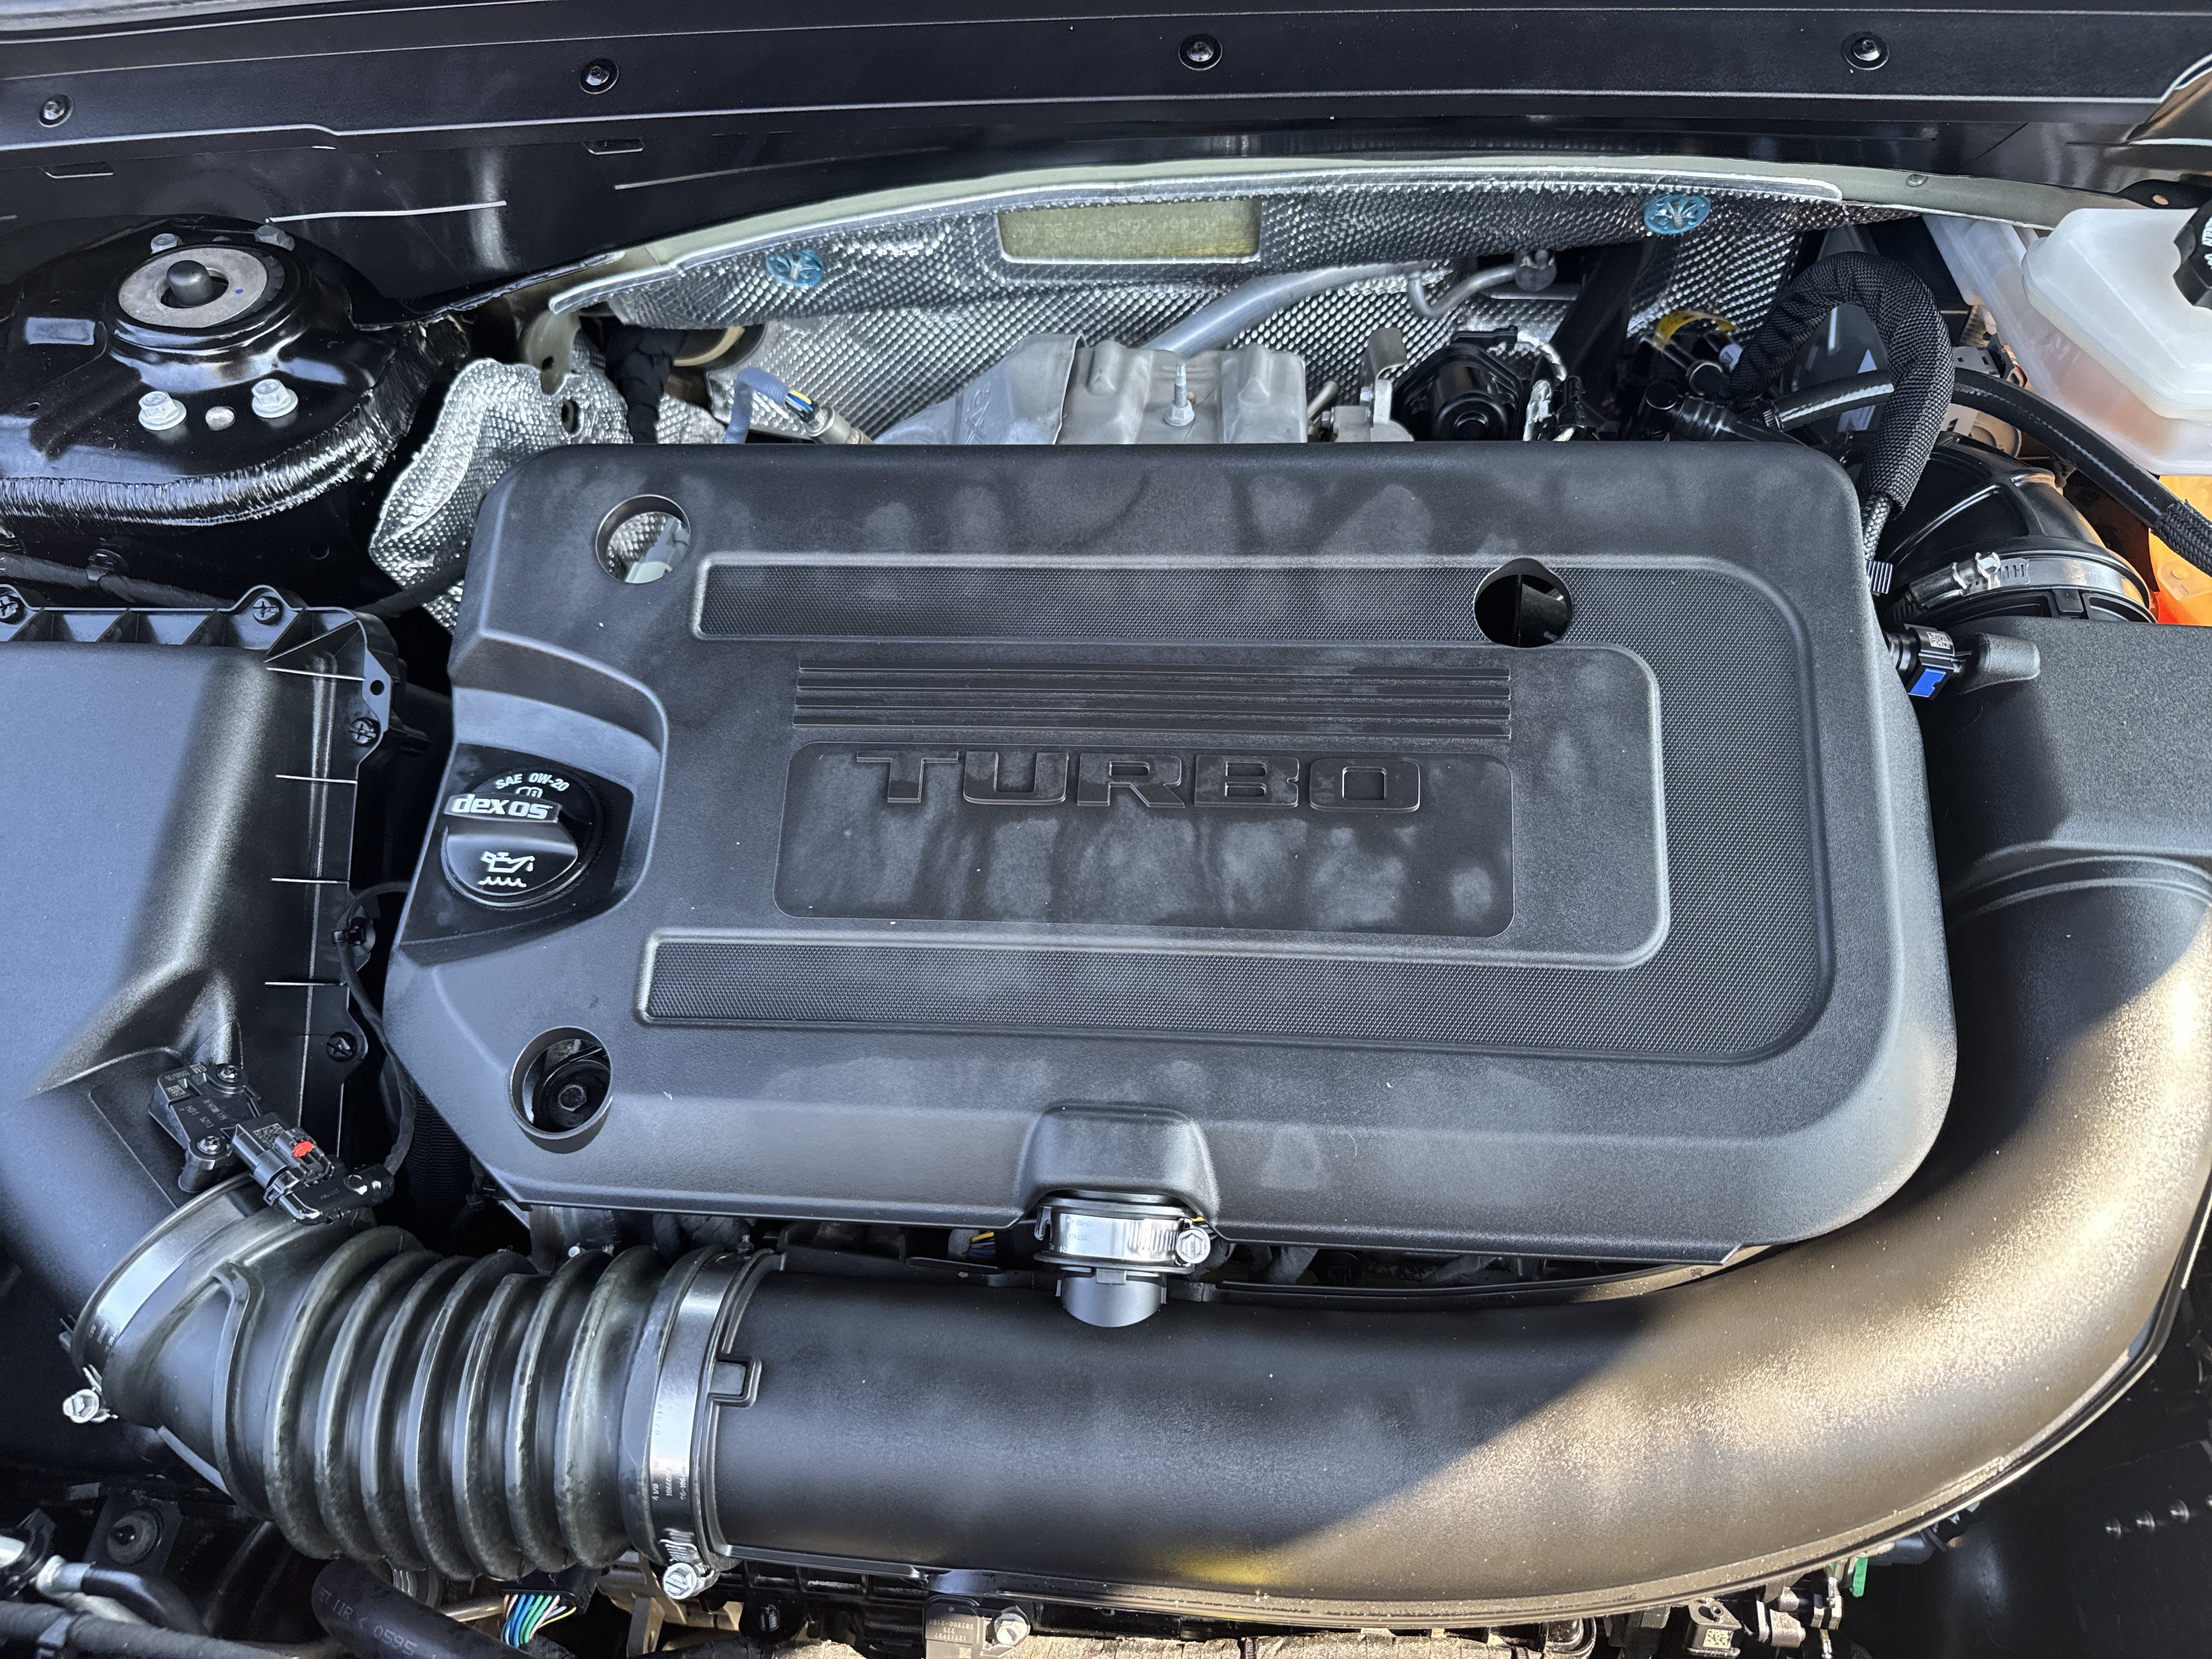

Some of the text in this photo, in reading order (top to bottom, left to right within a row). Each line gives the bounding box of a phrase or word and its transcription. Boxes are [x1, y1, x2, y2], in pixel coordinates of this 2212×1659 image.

[495, 772, 570, 792] SAE 0W-20
[856, 750, 1420, 812] TURBO
[452, 793, 550, 820] dexos
